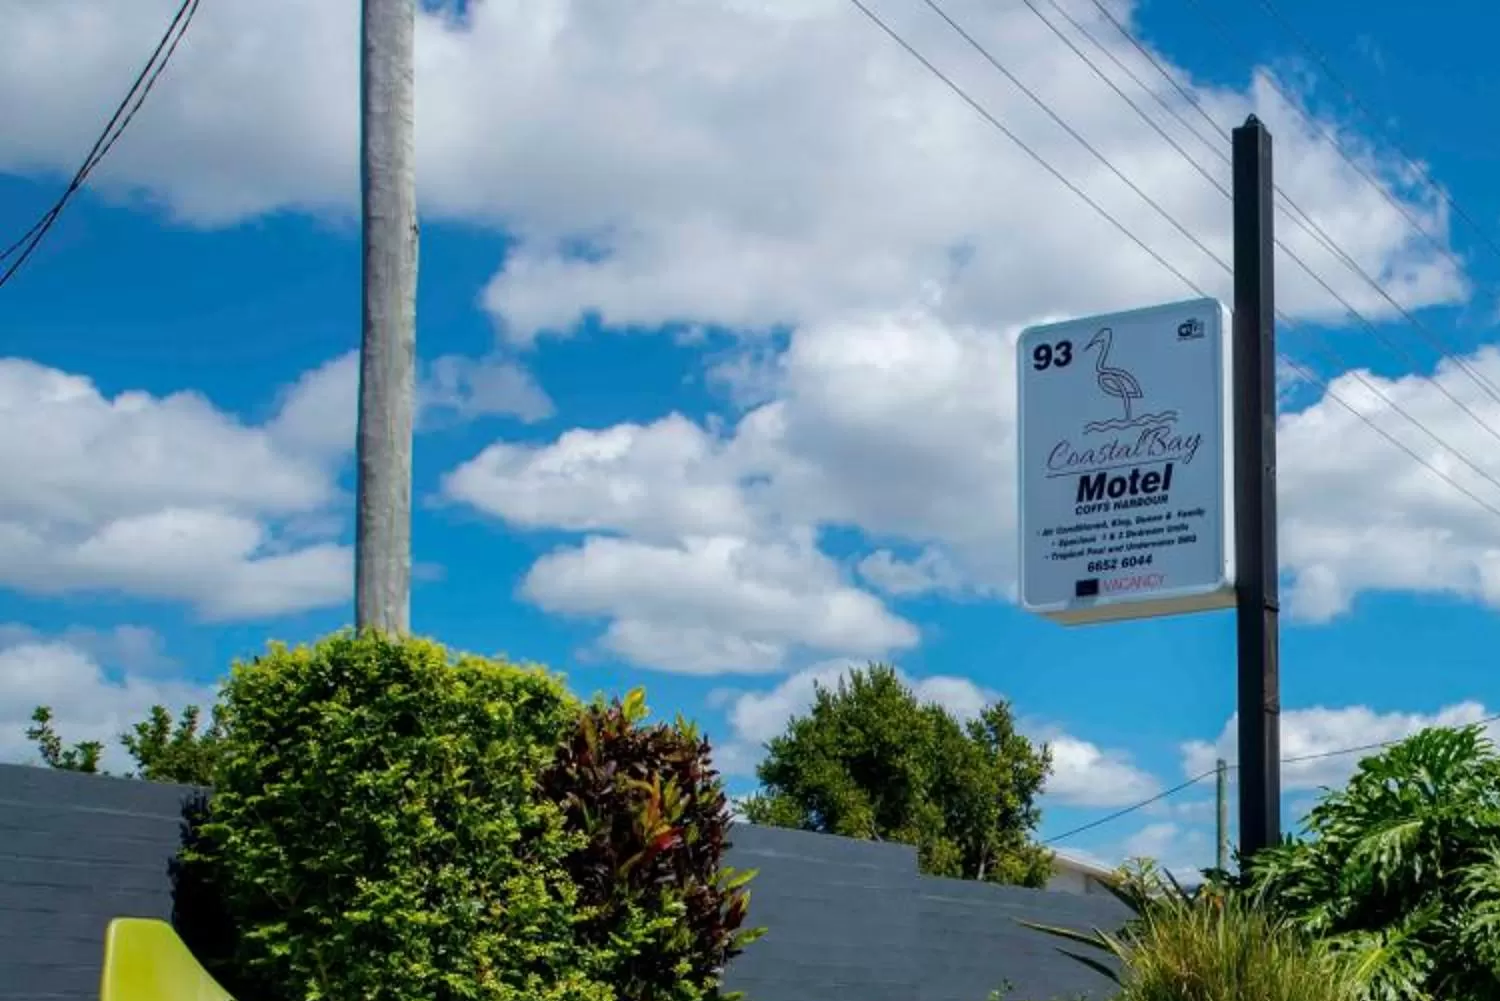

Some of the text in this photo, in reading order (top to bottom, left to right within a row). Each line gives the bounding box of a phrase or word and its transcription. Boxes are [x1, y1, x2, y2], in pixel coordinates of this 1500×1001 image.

[1033, 340, 1073, 371] 93
[1048, 425, 1201, 470] Coastal Bay
[1076, 463, 1173, 503] Motel
[1075, 493, 1169, 516] COFFS HARBOUR
[1121, 554, 1154, 570] 6044
[1102, 574, 1165, 592] VACANCY
